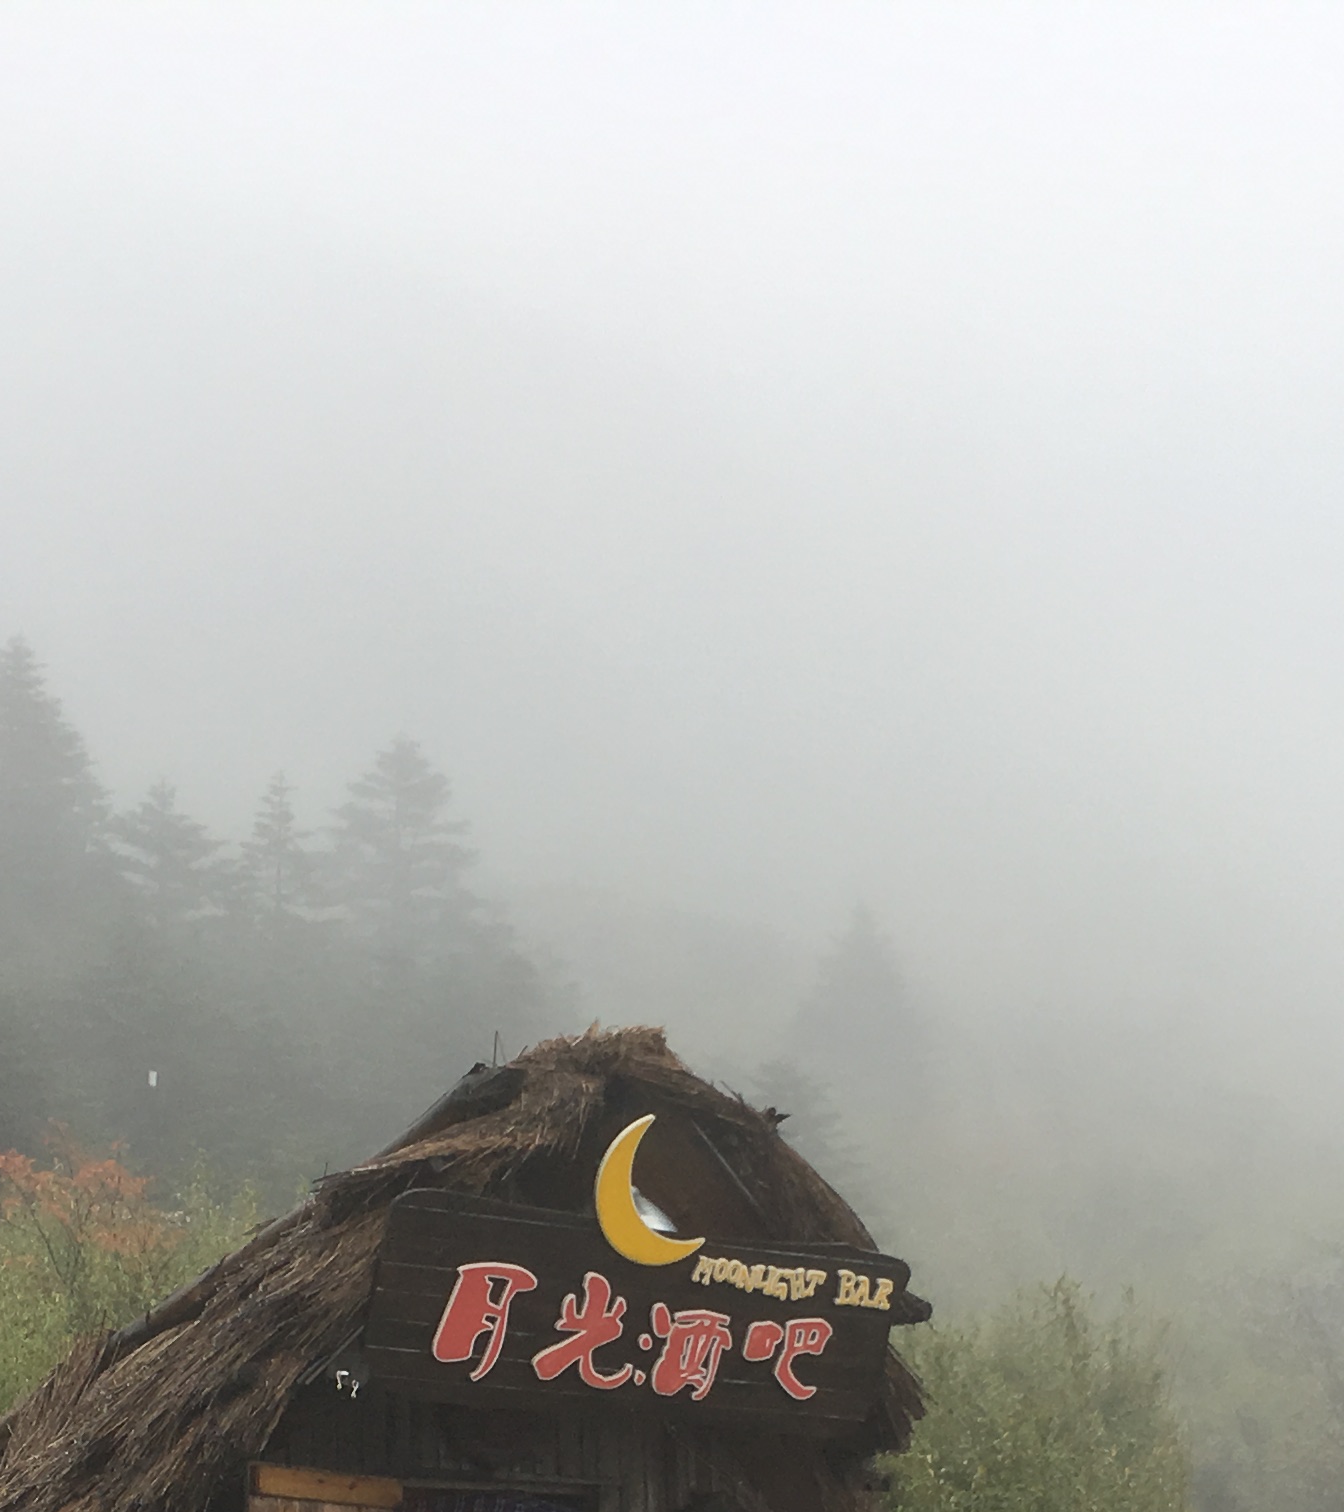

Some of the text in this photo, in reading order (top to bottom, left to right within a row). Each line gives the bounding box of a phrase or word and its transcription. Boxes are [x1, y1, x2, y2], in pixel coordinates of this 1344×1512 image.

[432, 1261, 833, 1400] 月光酒吧
[691, 1255, 894, 1310] MOONLIGHT BAR
